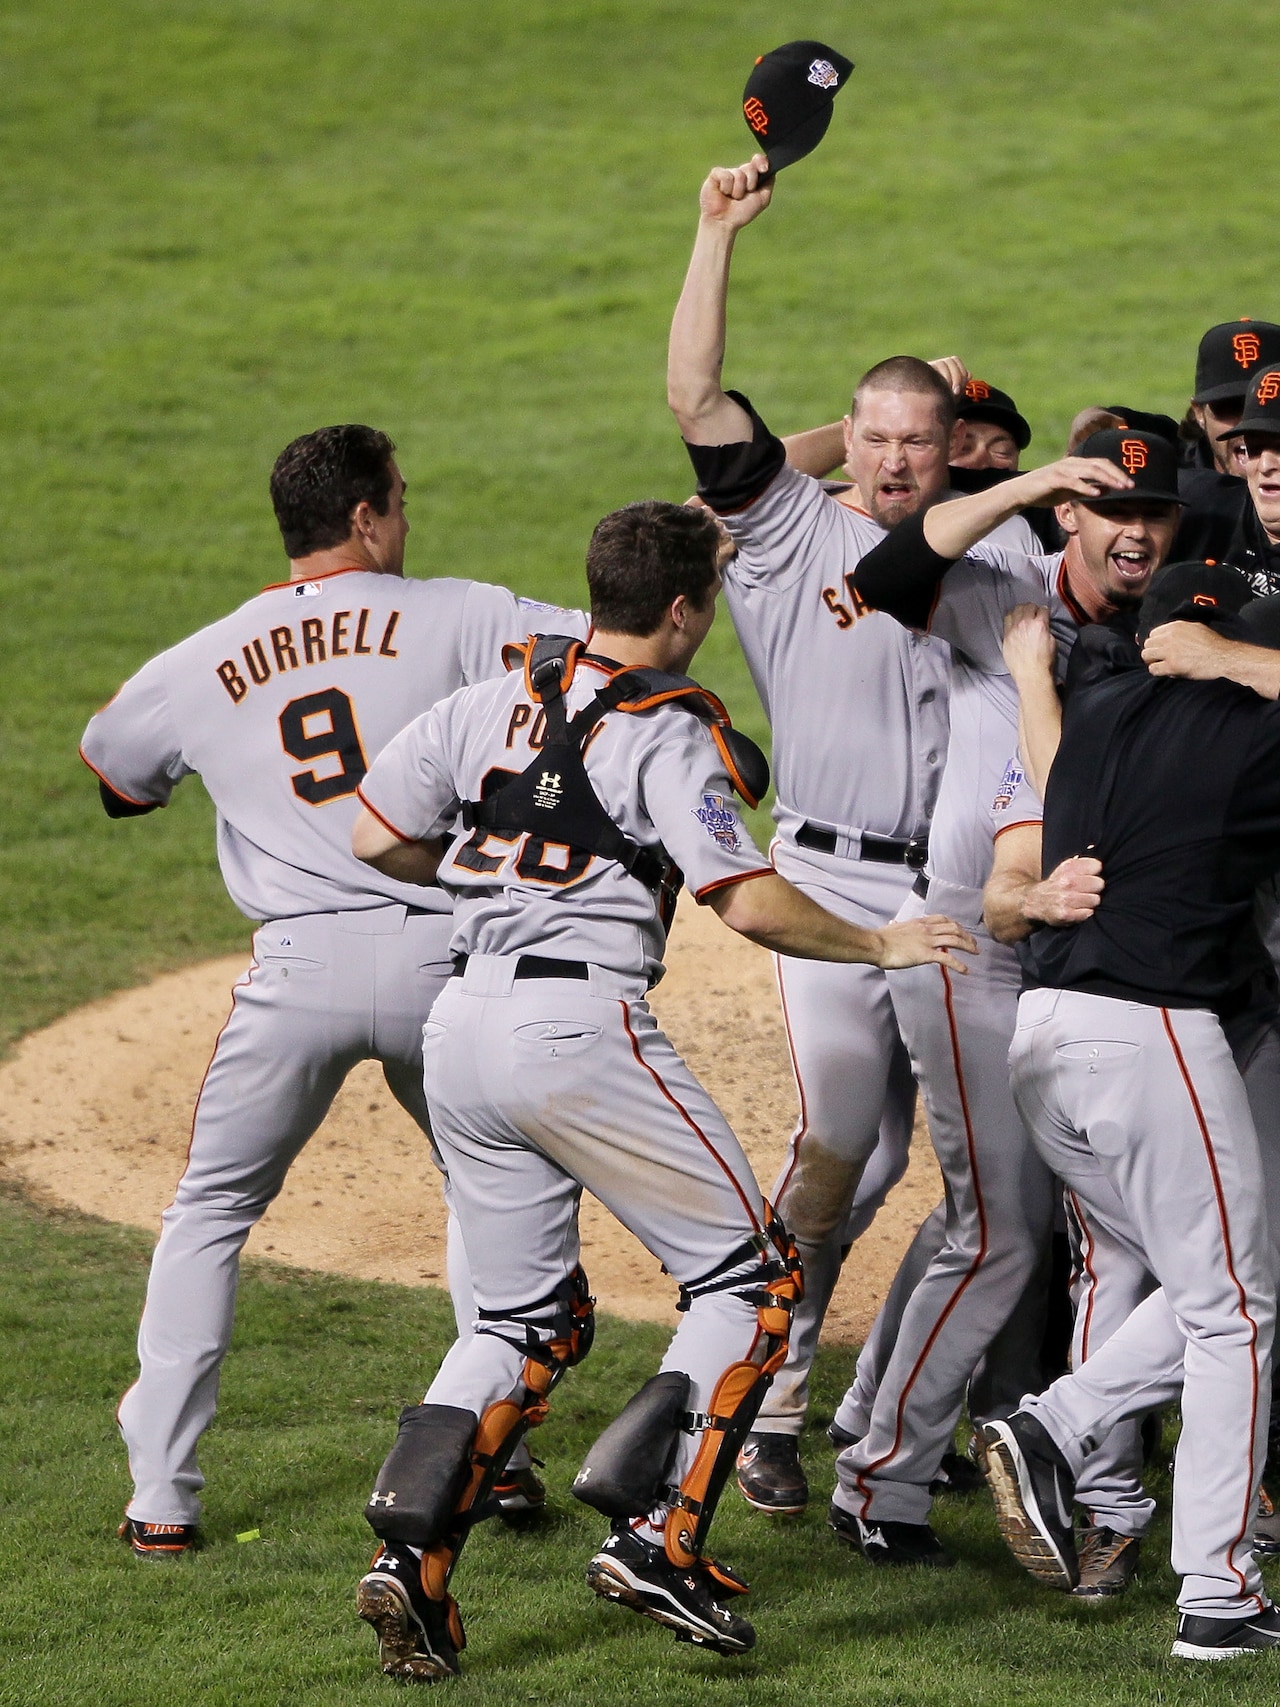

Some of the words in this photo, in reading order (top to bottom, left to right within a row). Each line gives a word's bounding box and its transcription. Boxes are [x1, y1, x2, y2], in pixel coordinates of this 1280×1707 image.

[743, 96, 769, 135] SF
[1232, 333, 1260, 369] SF
[1121, 439, 1148, 475] SF
[216, 608, 401, 704] BURRELL
[278, 686, 369, 807] 9
